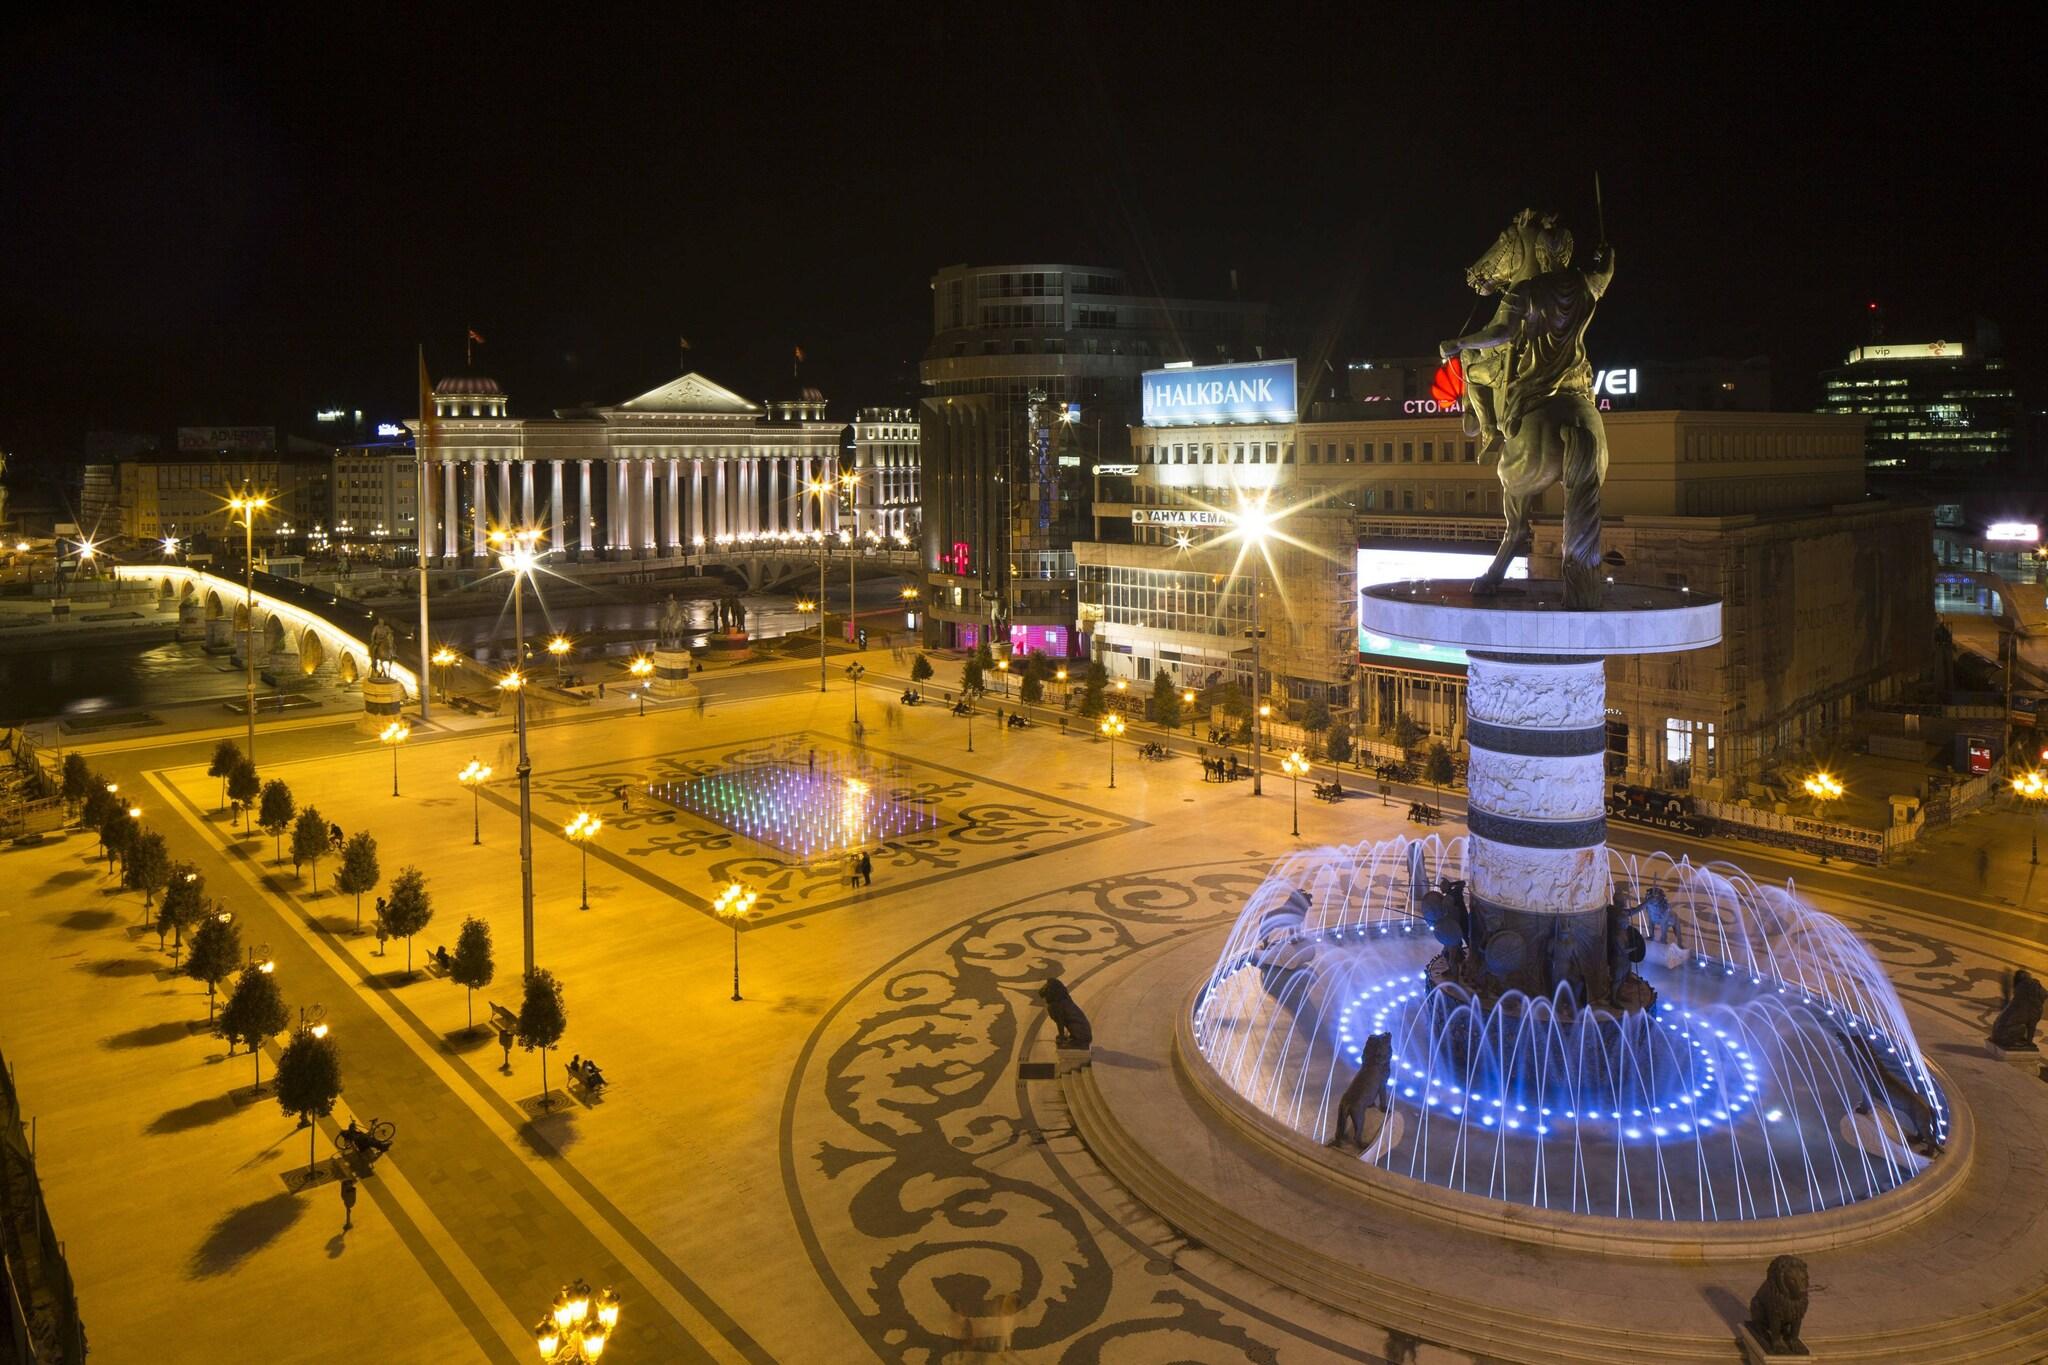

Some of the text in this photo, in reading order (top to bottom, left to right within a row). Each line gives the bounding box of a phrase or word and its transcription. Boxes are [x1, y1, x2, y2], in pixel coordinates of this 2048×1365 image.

[1874, 346, 1890, 357] vip
[1156, 378, 1274, 407] HALKBANK
[1146, 511, 1228, 524] YAHYA KEMA
